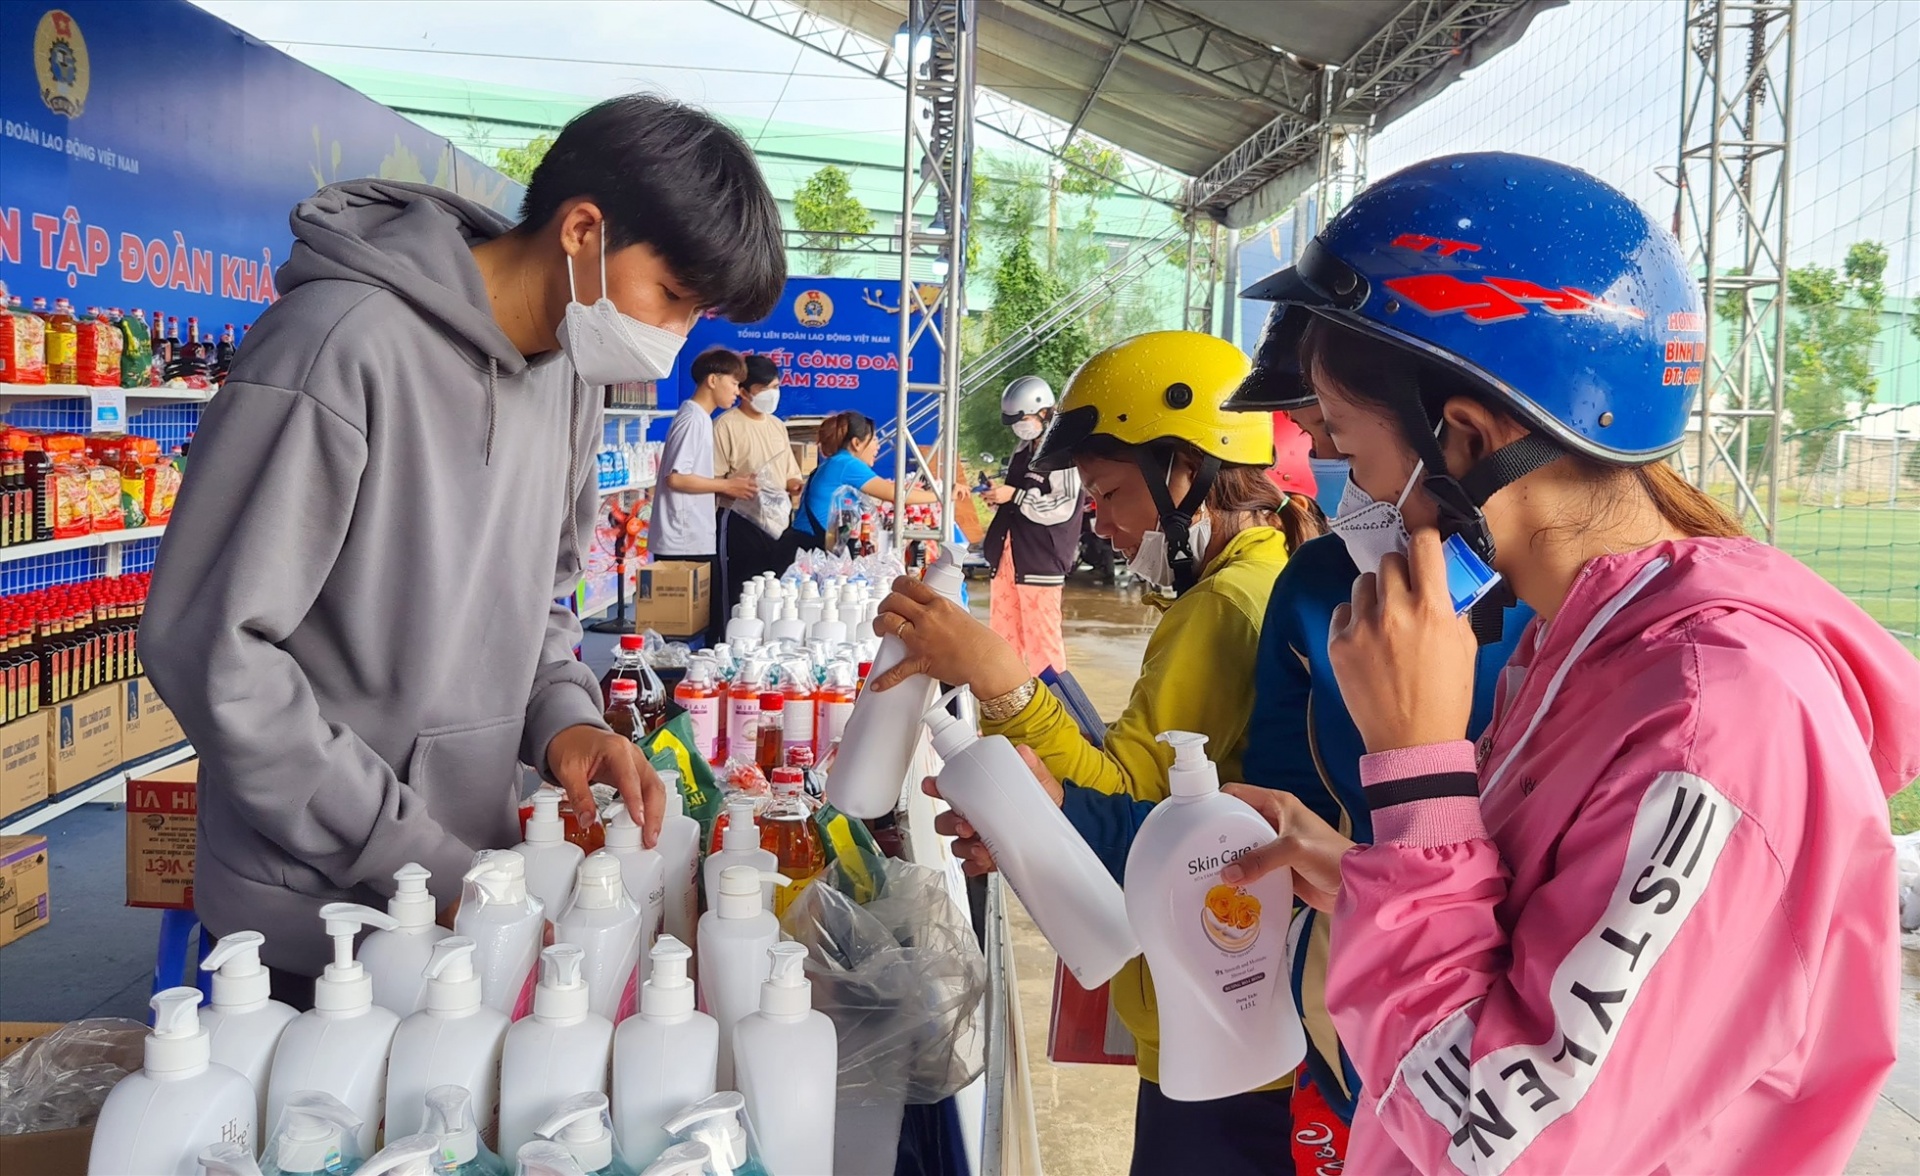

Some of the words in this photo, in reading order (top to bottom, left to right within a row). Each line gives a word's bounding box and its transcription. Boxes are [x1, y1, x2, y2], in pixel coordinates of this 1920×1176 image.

[5, 121, 39, 145] ĐOÀN
[42, 132, 63, 151] LAO
[65, 138, 96, 161] ĐỘNG
[97, 148, 116, 170] VIỆT
[118, 157, 139, 174] NAM
[33, 205, 110, 288] TẬP
[119, 231, 213, 295] ĐOÀN
[221, 246, 282, 304] KHẢ
[737, 329, 761, 339] TỔNG
[763, 331, 780, 339] LIÊN
[781, 331, 807, 340] ĐOÀN
[808, 333, 824, 341] LAO
[826, 333, 851, 343] ĐỘNG
[853, 334, 870, 344] VIỆT
[799, 349, 853, 369] CÔNG
[1665, 336, 1694, 362] BÌNH
[779, 369, 811, 387] ĂM
[815, 372, 860, 389] 2023
[145, 856, 184, 876] VIỆT
[1188, 856, 1219, 875] Skin
[1221, 846, 1252, 864] Care
